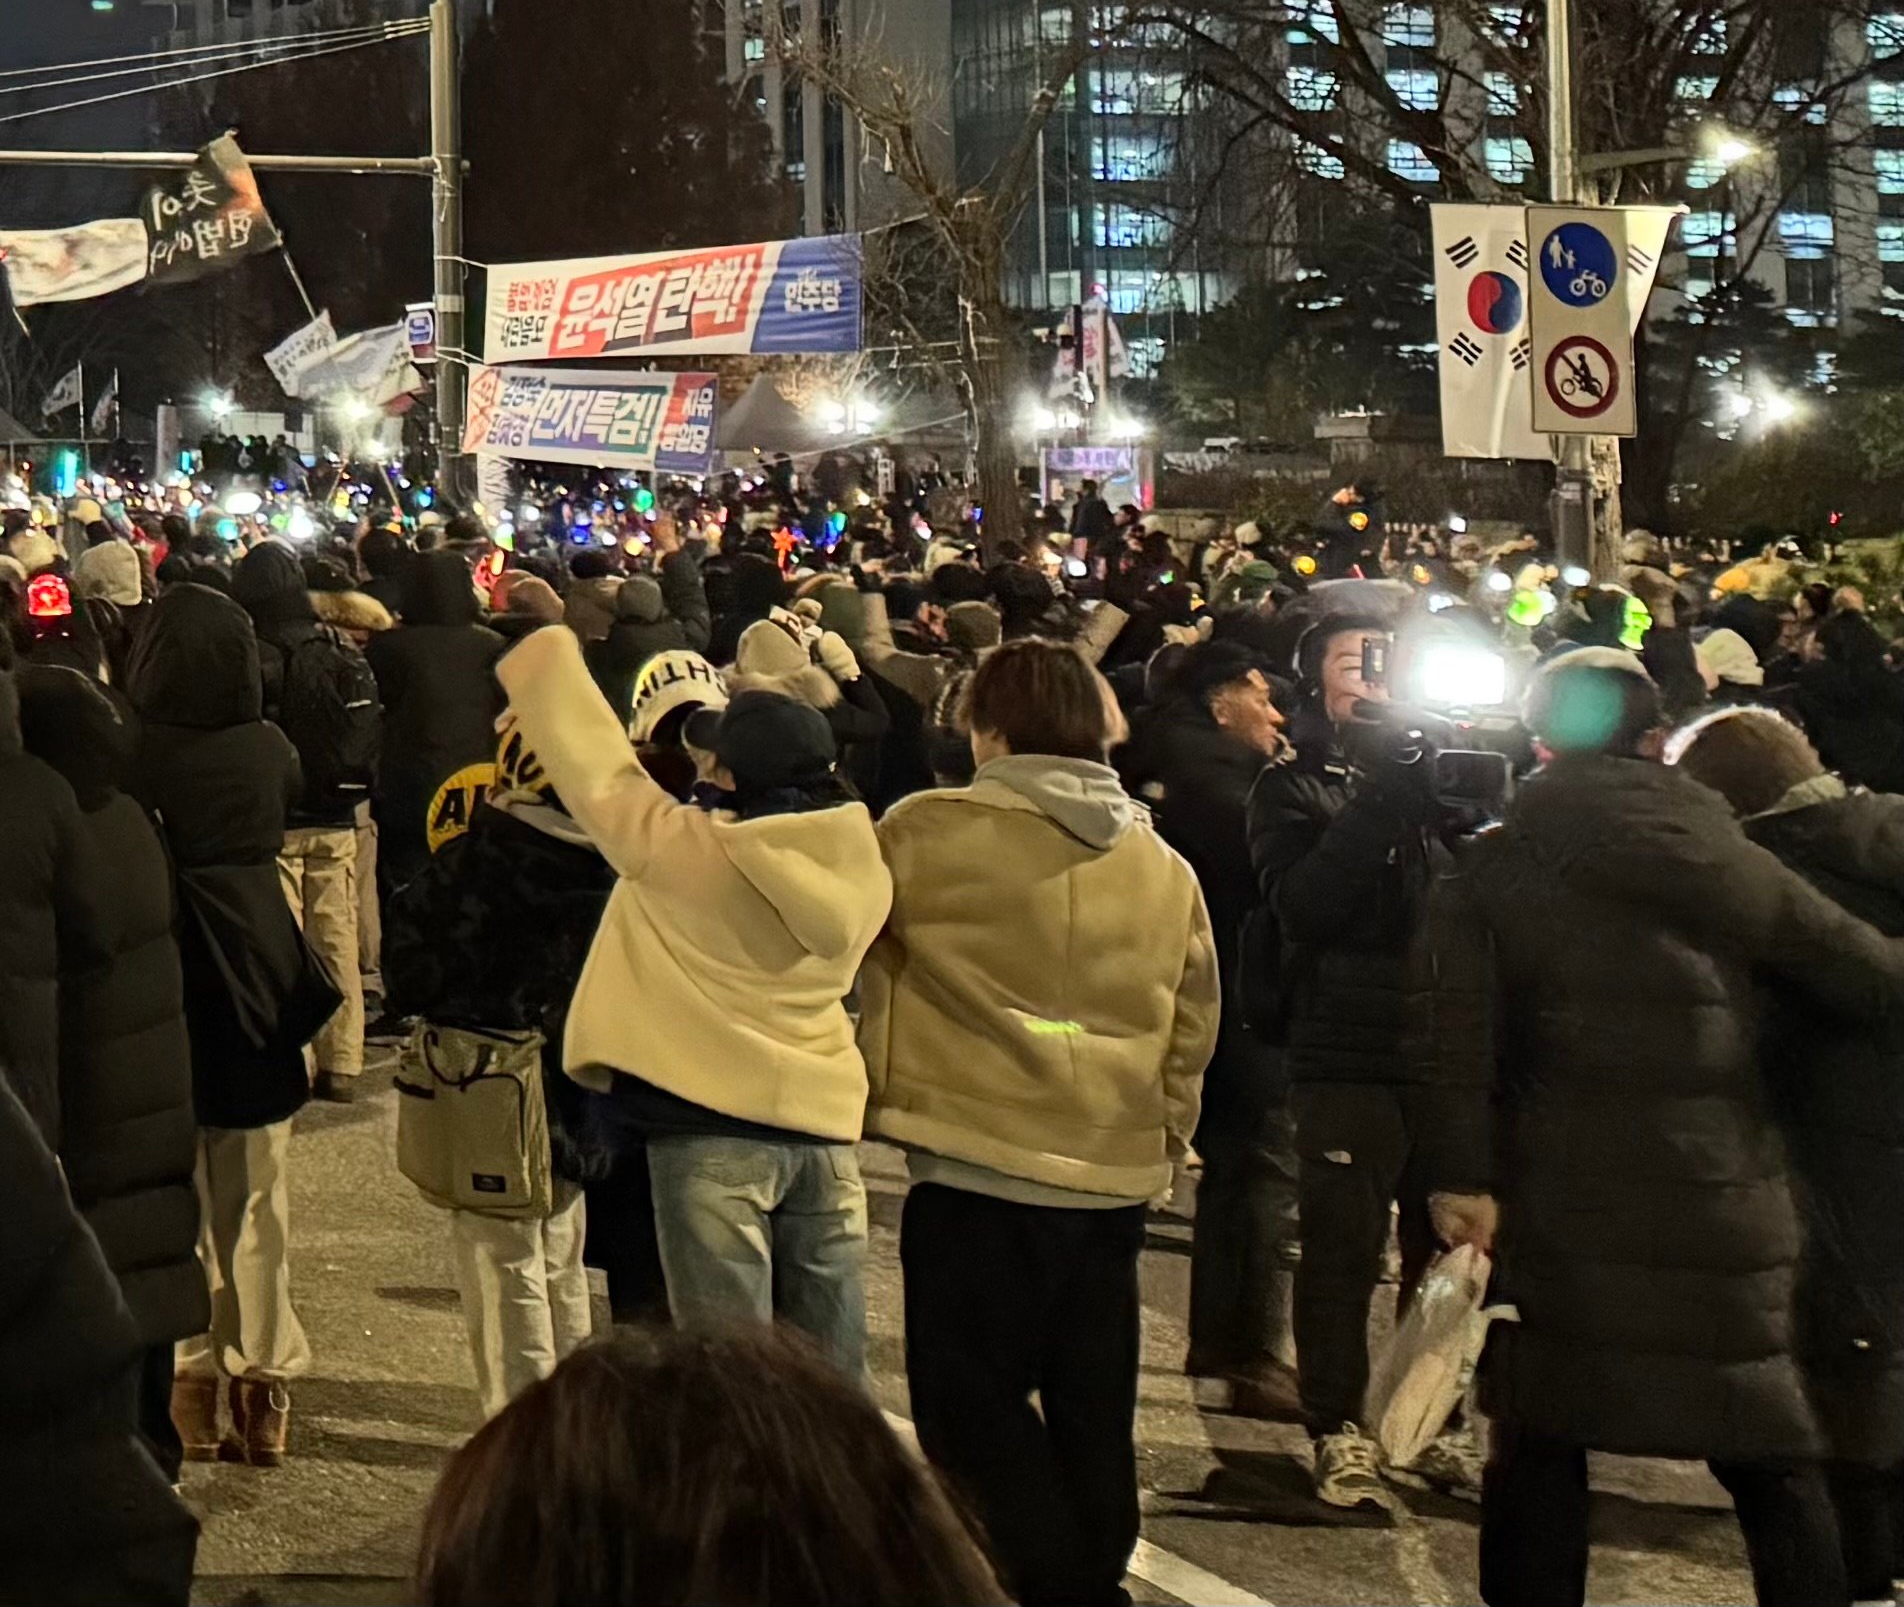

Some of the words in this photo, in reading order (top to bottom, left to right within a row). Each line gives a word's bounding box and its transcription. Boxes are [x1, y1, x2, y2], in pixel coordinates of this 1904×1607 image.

[556, 276, 653, 350] 윤석열
[653, 252, 756, 331] 탄핵!
[784, 279, 842, 313] 민주당
